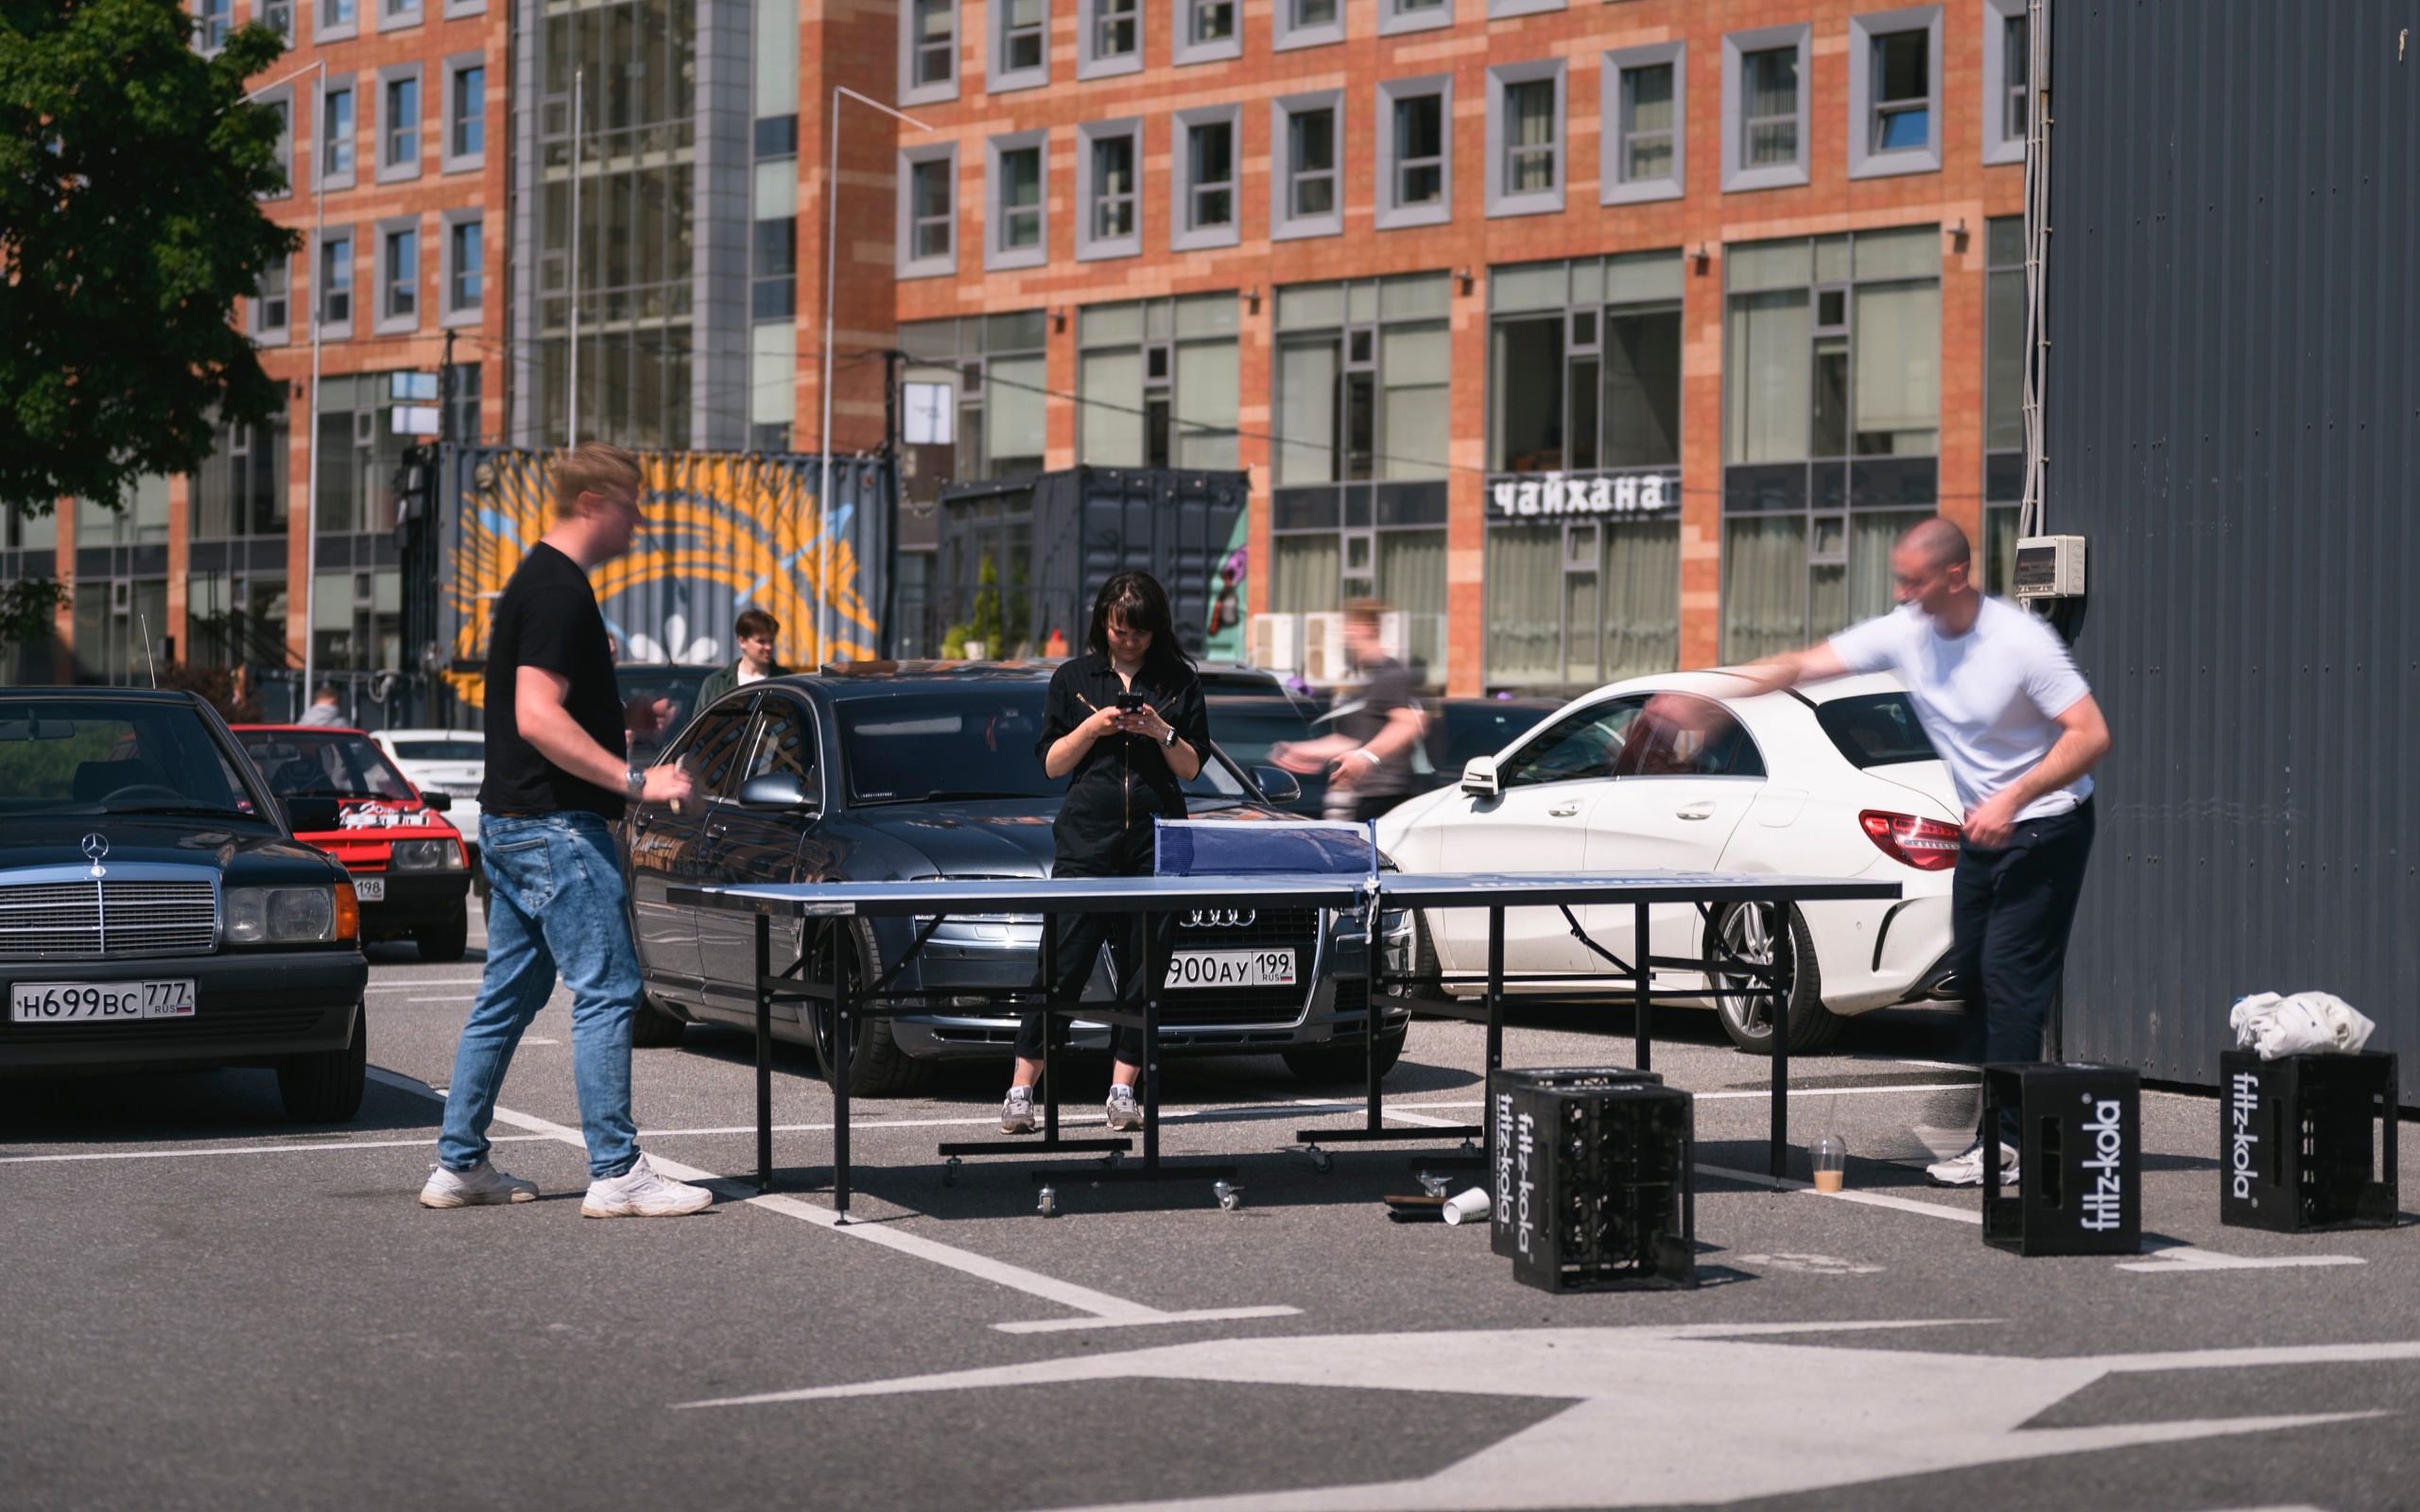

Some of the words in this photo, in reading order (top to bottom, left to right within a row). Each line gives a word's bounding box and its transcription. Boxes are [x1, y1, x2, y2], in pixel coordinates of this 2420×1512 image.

[1495, 472, 1665, 516] чайхана
[356, 881, 380, 894] 198
[1169, 956, 1249, 984] 900АУ
[1255, 954, 1289, 974] 199
[1262, 973, 1280, 982] RUS
[145, 983, 186, 1005] 777
[154, 1005, 176, 1014] RUS
[2233, 1072, 2258, 1199] fritz-kola
[1500, 1092, 1513, 1225] fritz-kola
[2081, 1101, 2121, 1231] fritz-kola
[1518, 1111, 1534, 1253] fritz-kola
